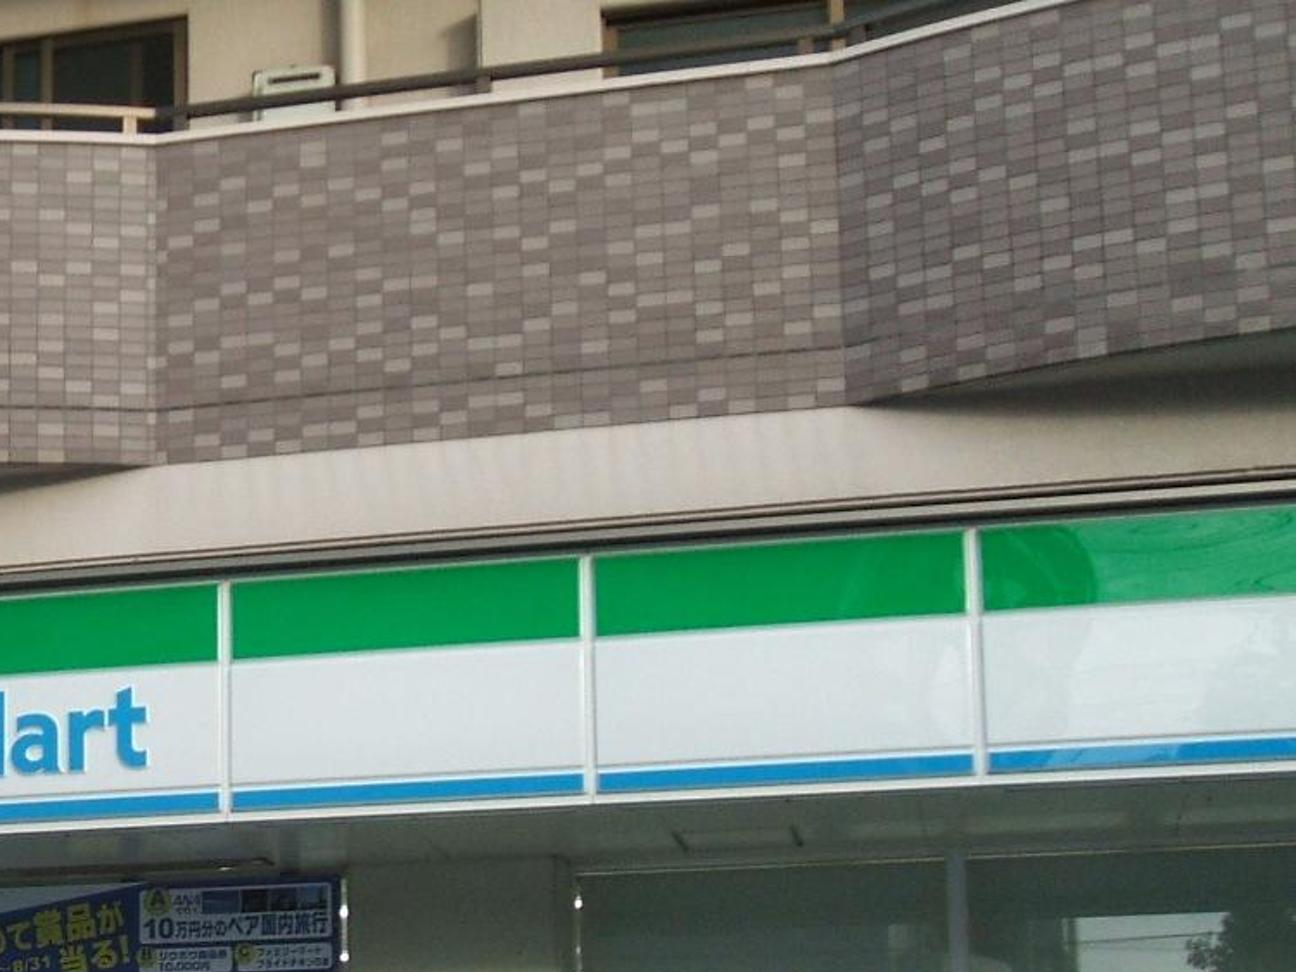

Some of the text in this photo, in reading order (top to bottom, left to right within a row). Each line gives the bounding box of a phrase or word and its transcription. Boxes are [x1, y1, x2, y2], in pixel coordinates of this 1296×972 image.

[144, 911, 329, 940] 10万円分のペア国内旅行
